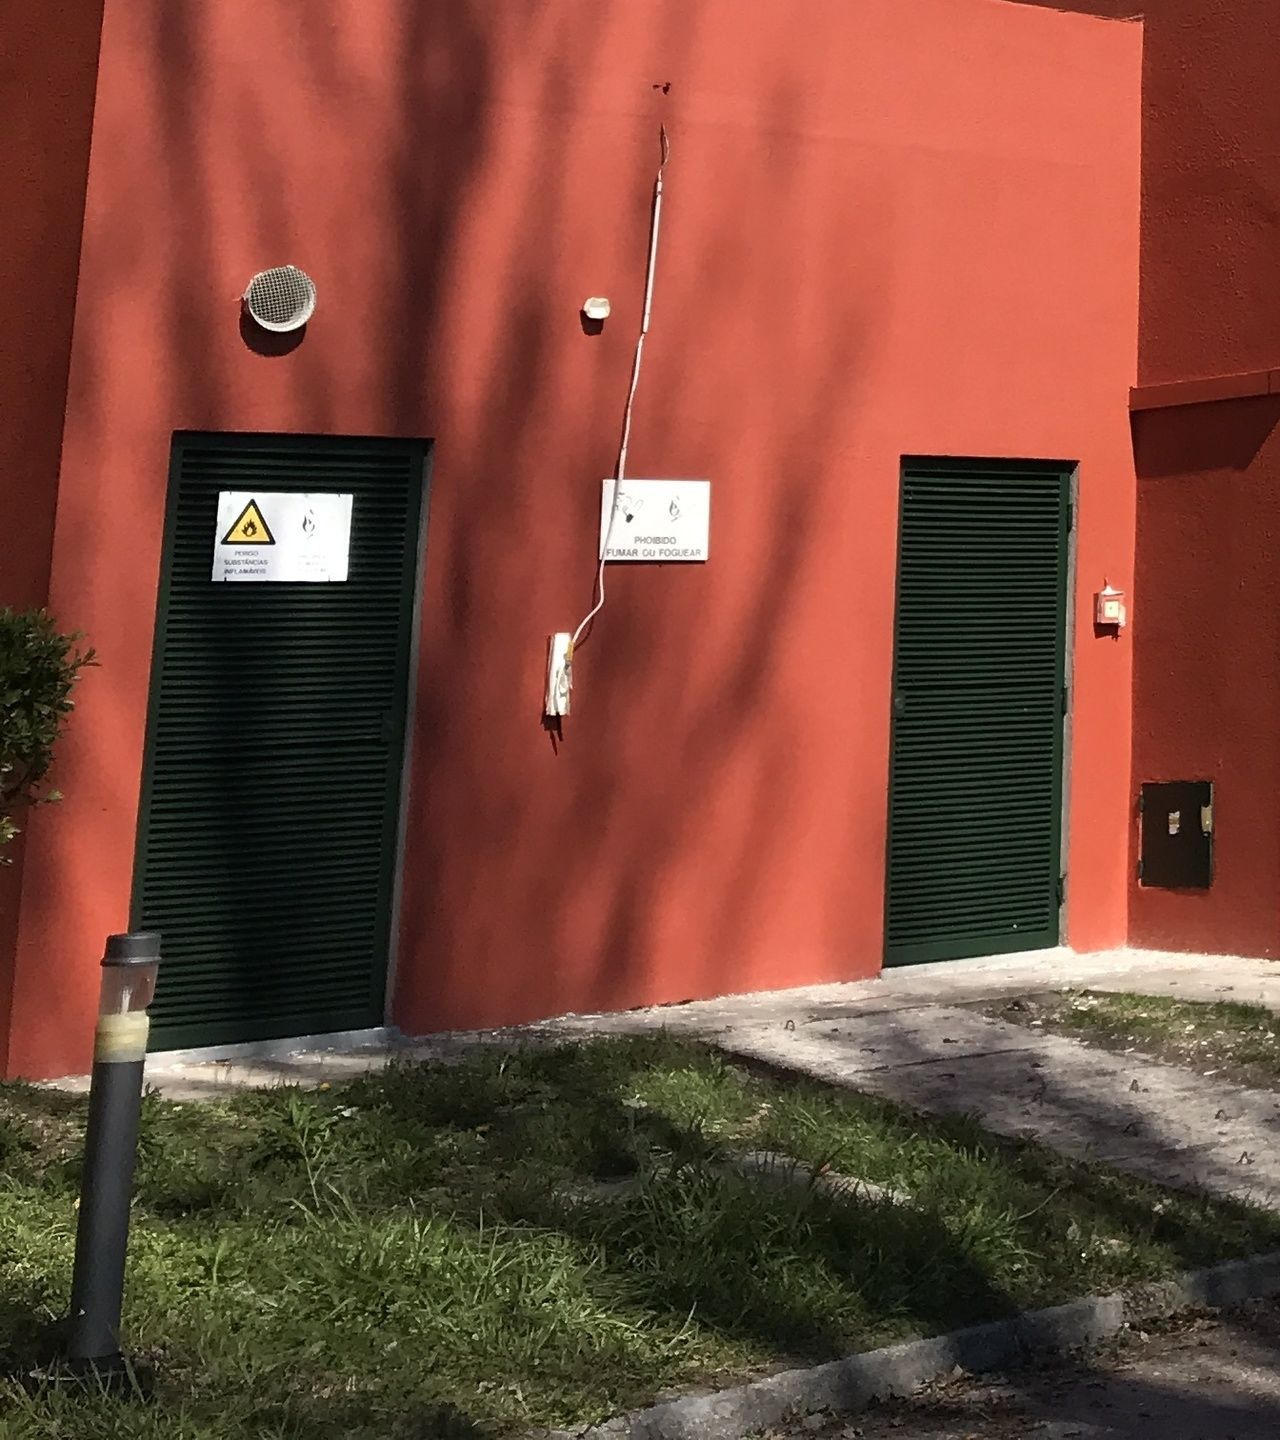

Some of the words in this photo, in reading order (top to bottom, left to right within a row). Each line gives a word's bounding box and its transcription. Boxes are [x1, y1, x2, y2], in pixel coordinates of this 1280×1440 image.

[606, 548, 638, 557] FUMAR
[642, 548, 656, 557] OU
[658, 548, 702, 557] FOGUEAR
